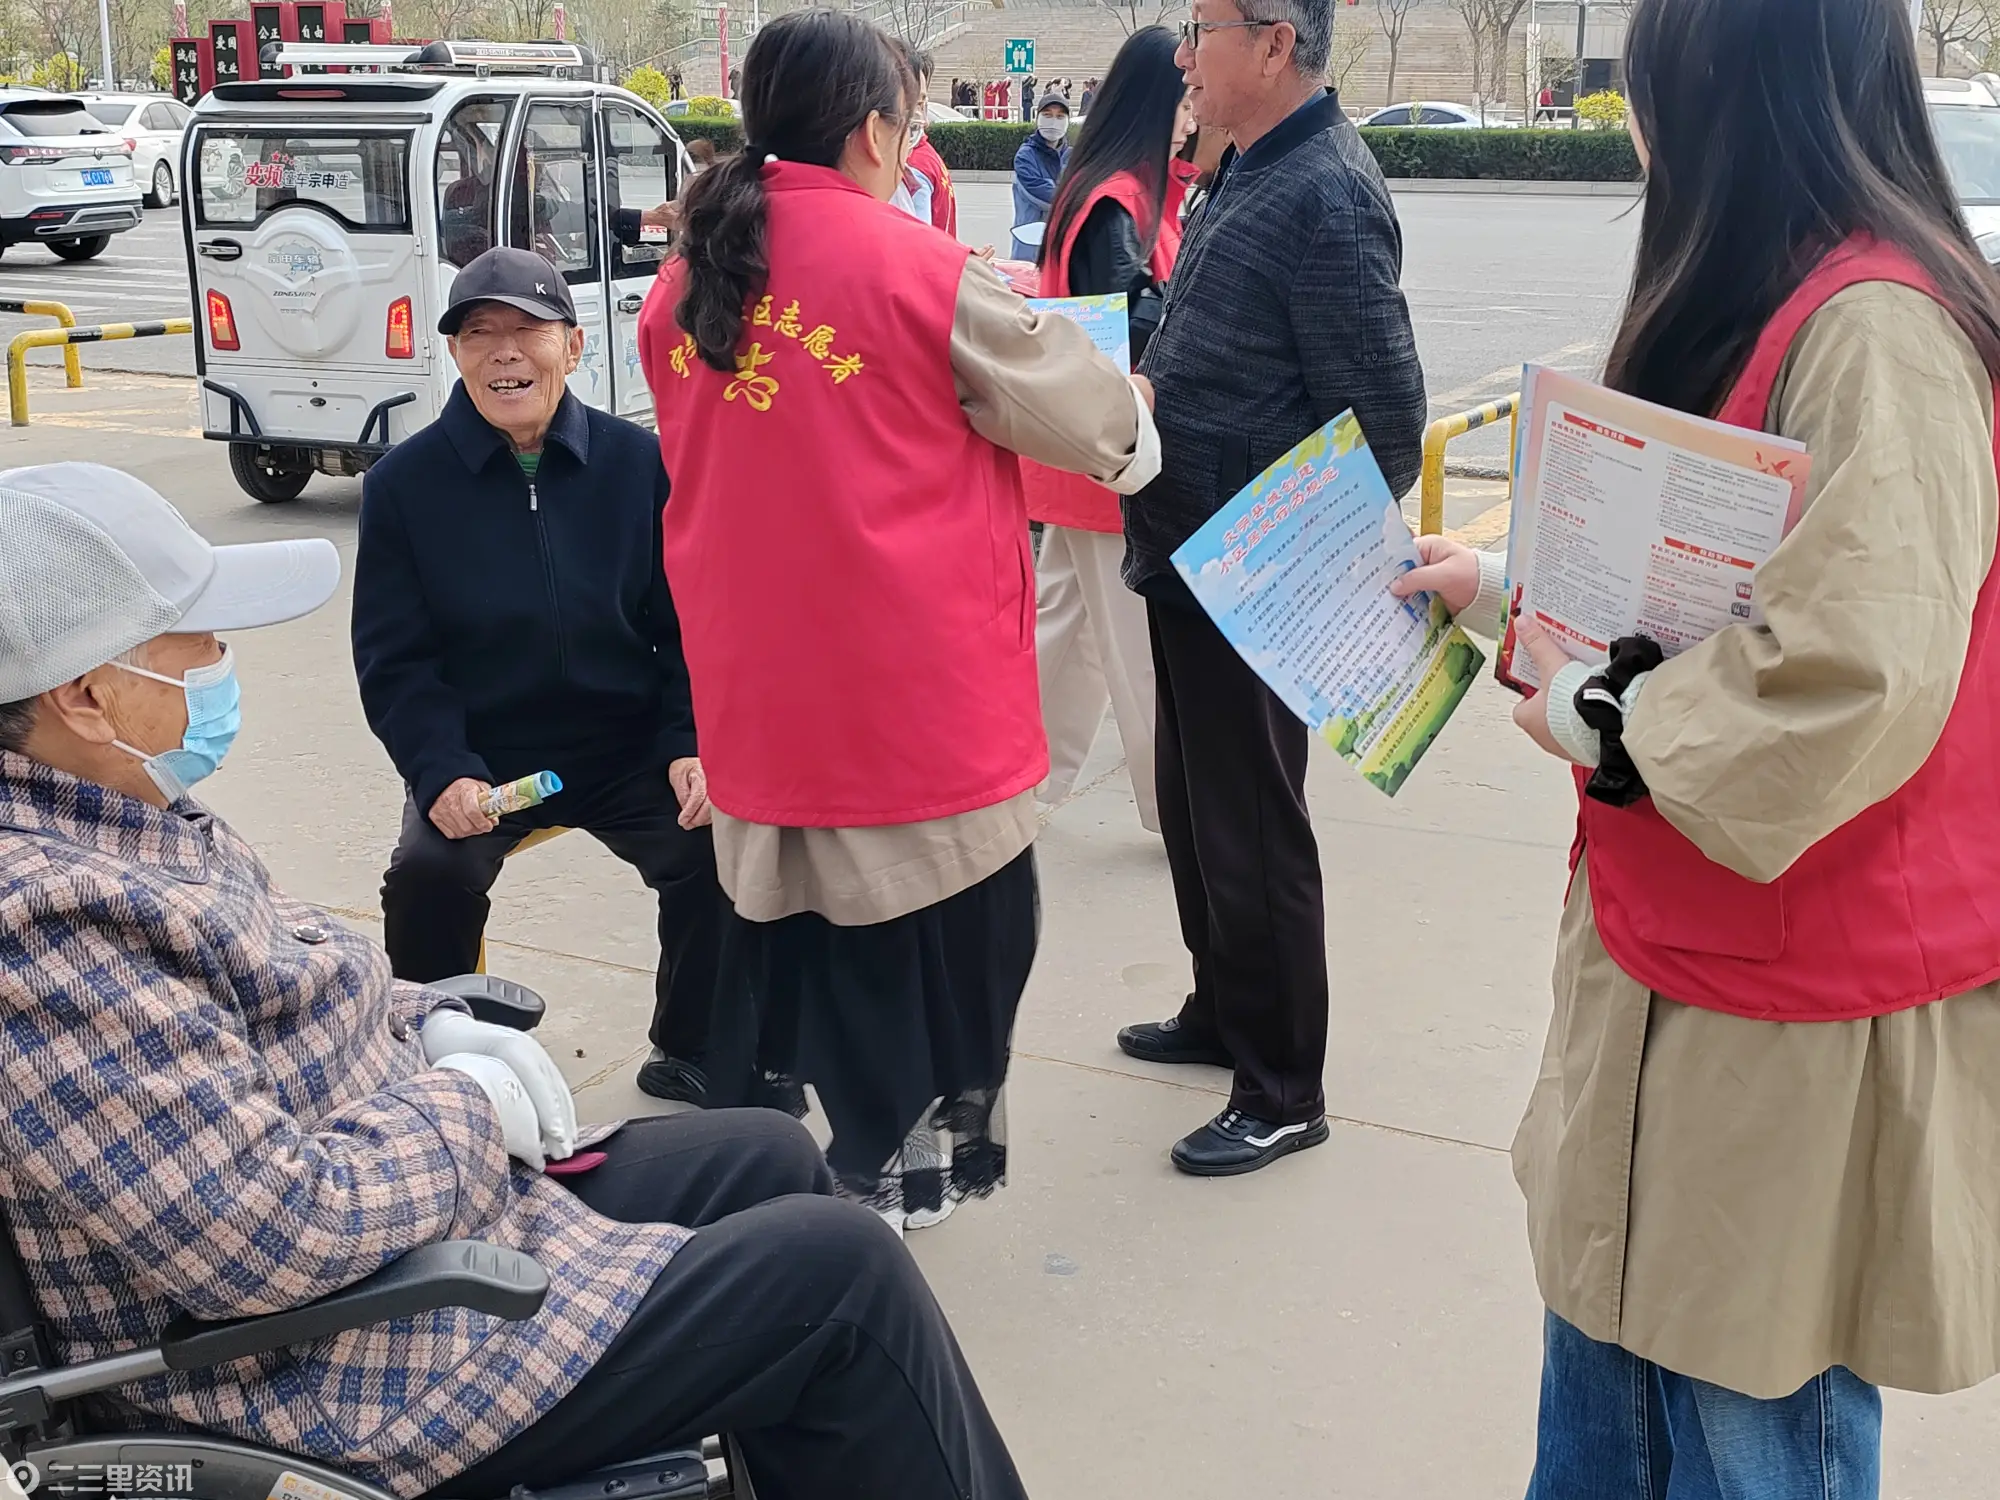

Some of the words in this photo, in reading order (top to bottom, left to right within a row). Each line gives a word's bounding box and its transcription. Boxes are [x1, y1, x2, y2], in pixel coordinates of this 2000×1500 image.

[258, 25, 281, 40] 公正
[301, 25, 324, 38] 自由
[178, 68, 198, 83] 友善
[535, 282, 547, 295] K
